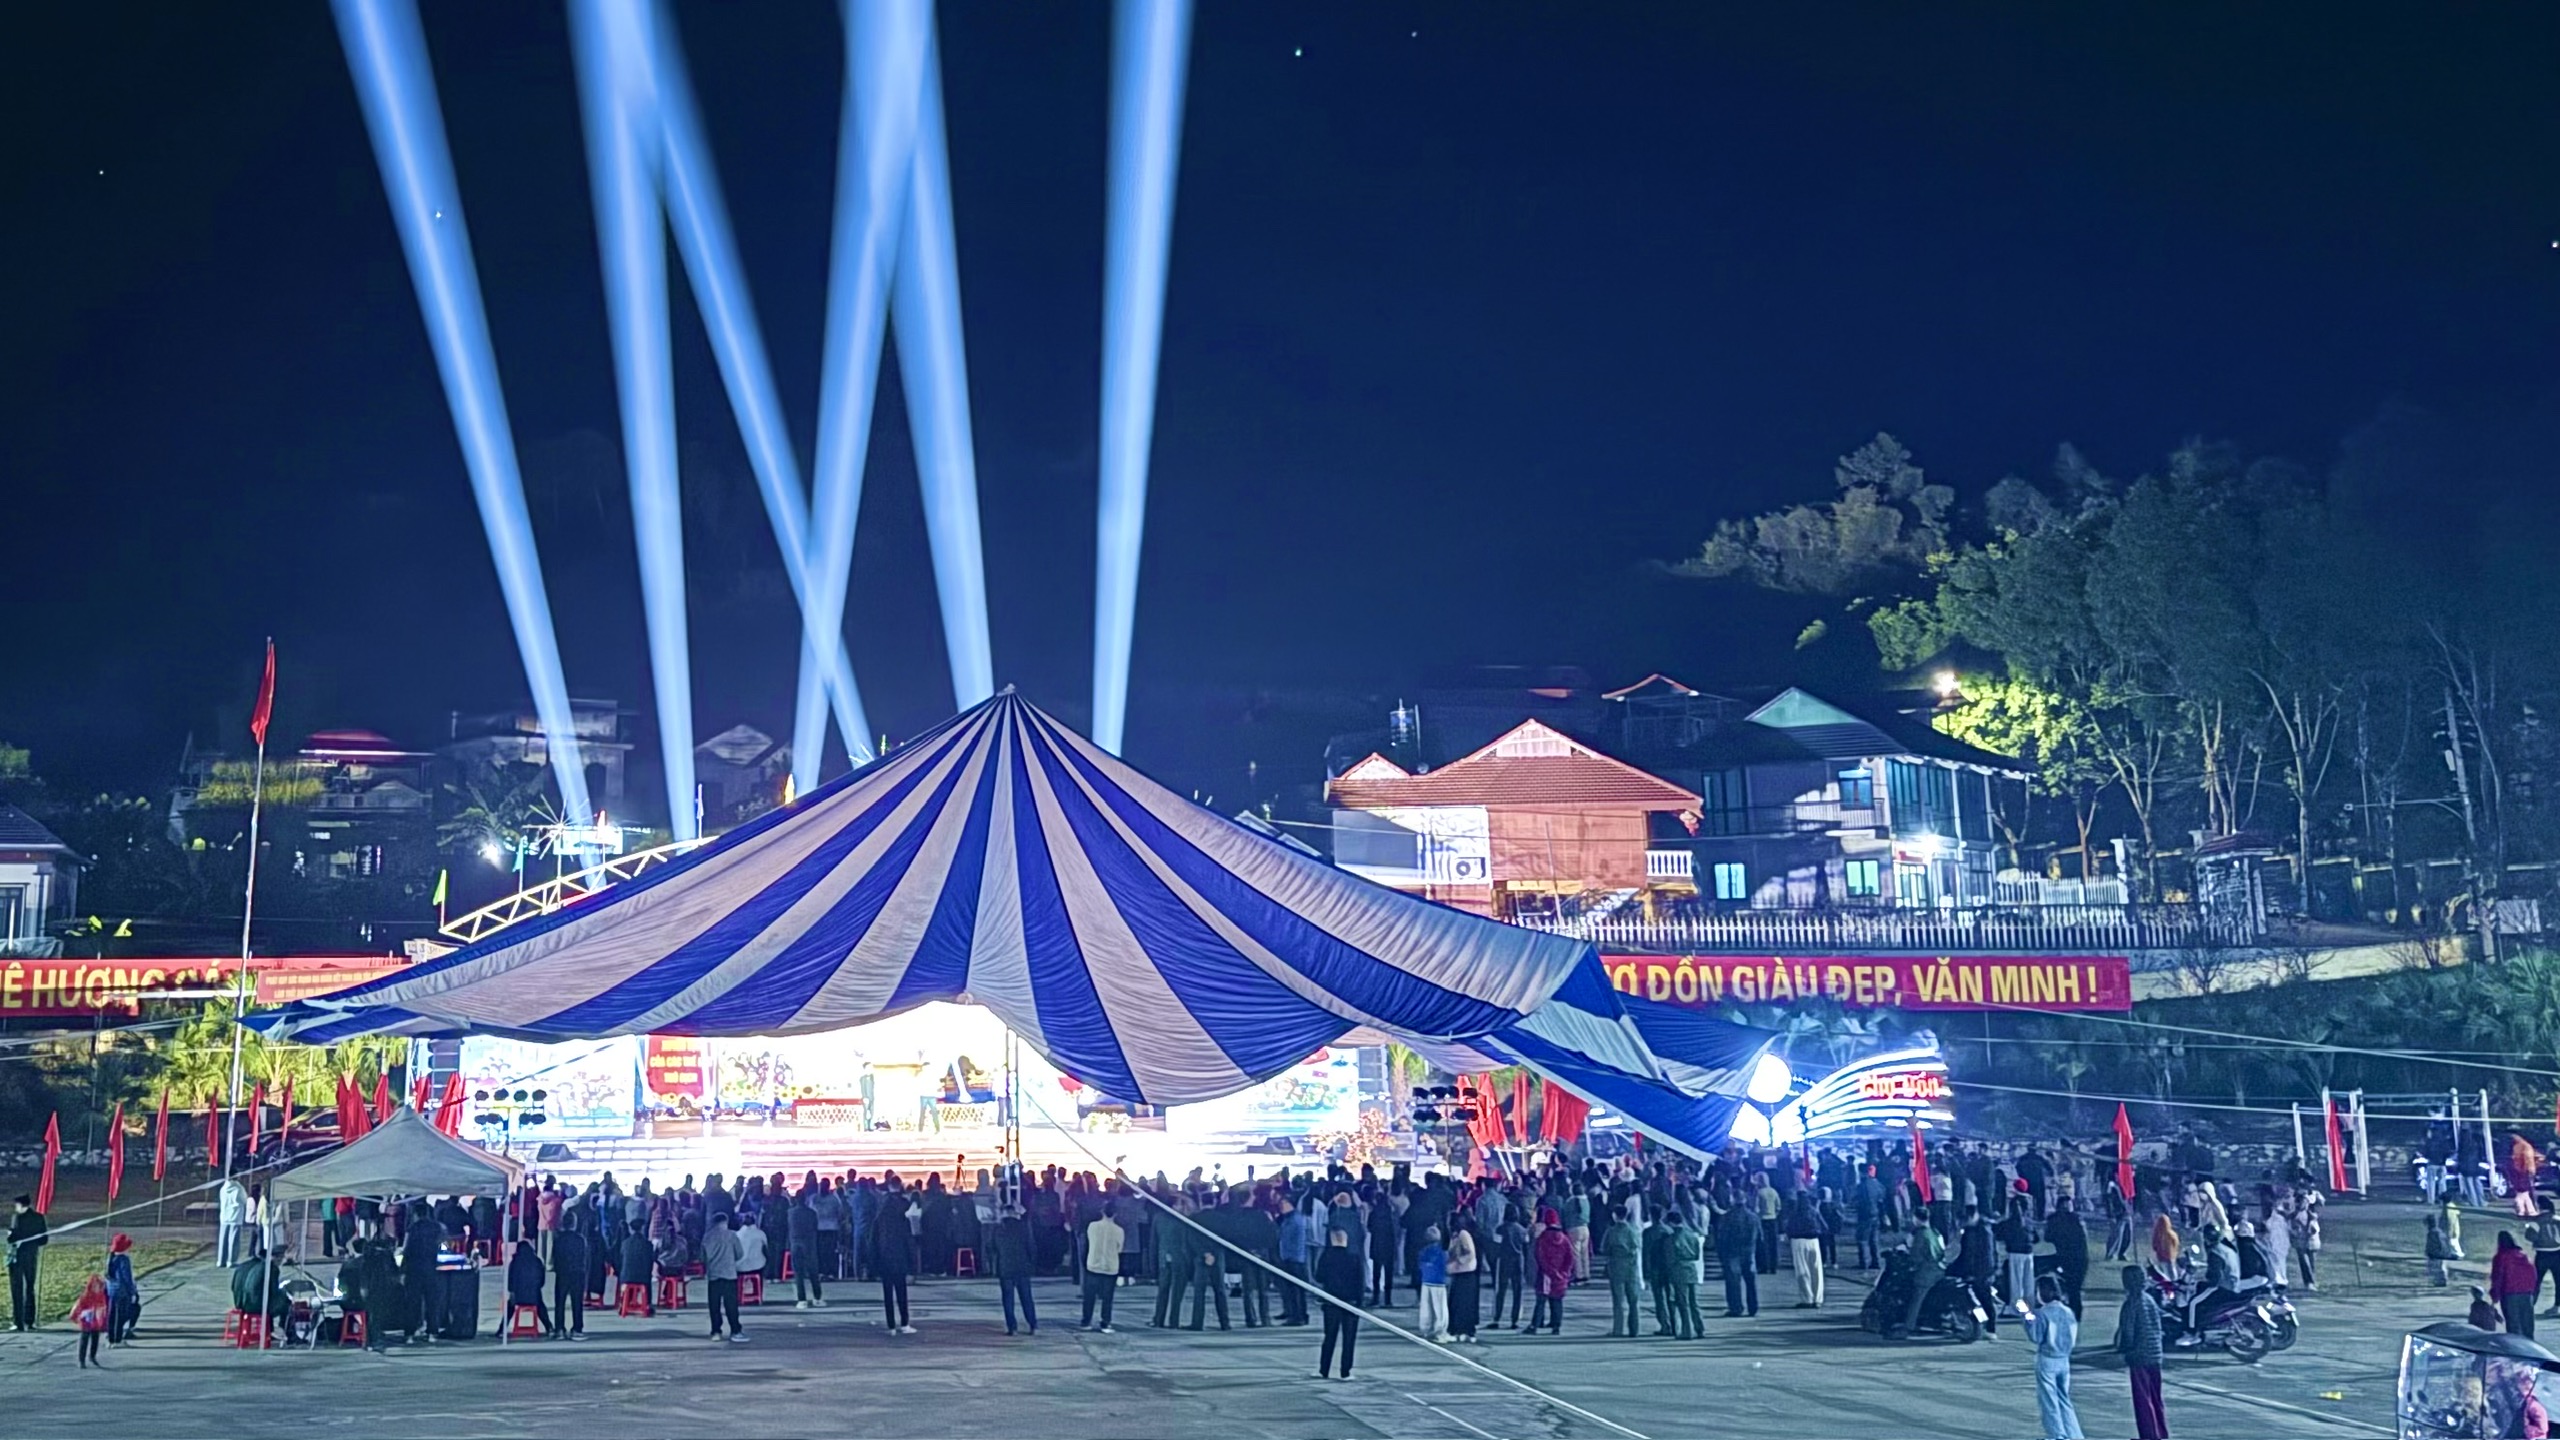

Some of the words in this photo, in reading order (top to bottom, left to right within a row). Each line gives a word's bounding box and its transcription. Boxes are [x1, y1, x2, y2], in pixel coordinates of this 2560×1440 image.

[0, 962, 25, 1008] Ê
[1647, 955, 1723, 1003] ĐỒN
[1732, 957, 1818, 1002] GIÀU
[1824, 965, 1901, 1006] ĐẸP,
[1912, 957, 1983, 1003] VĂN
[1990, 965, 2080, 1003] MINH
